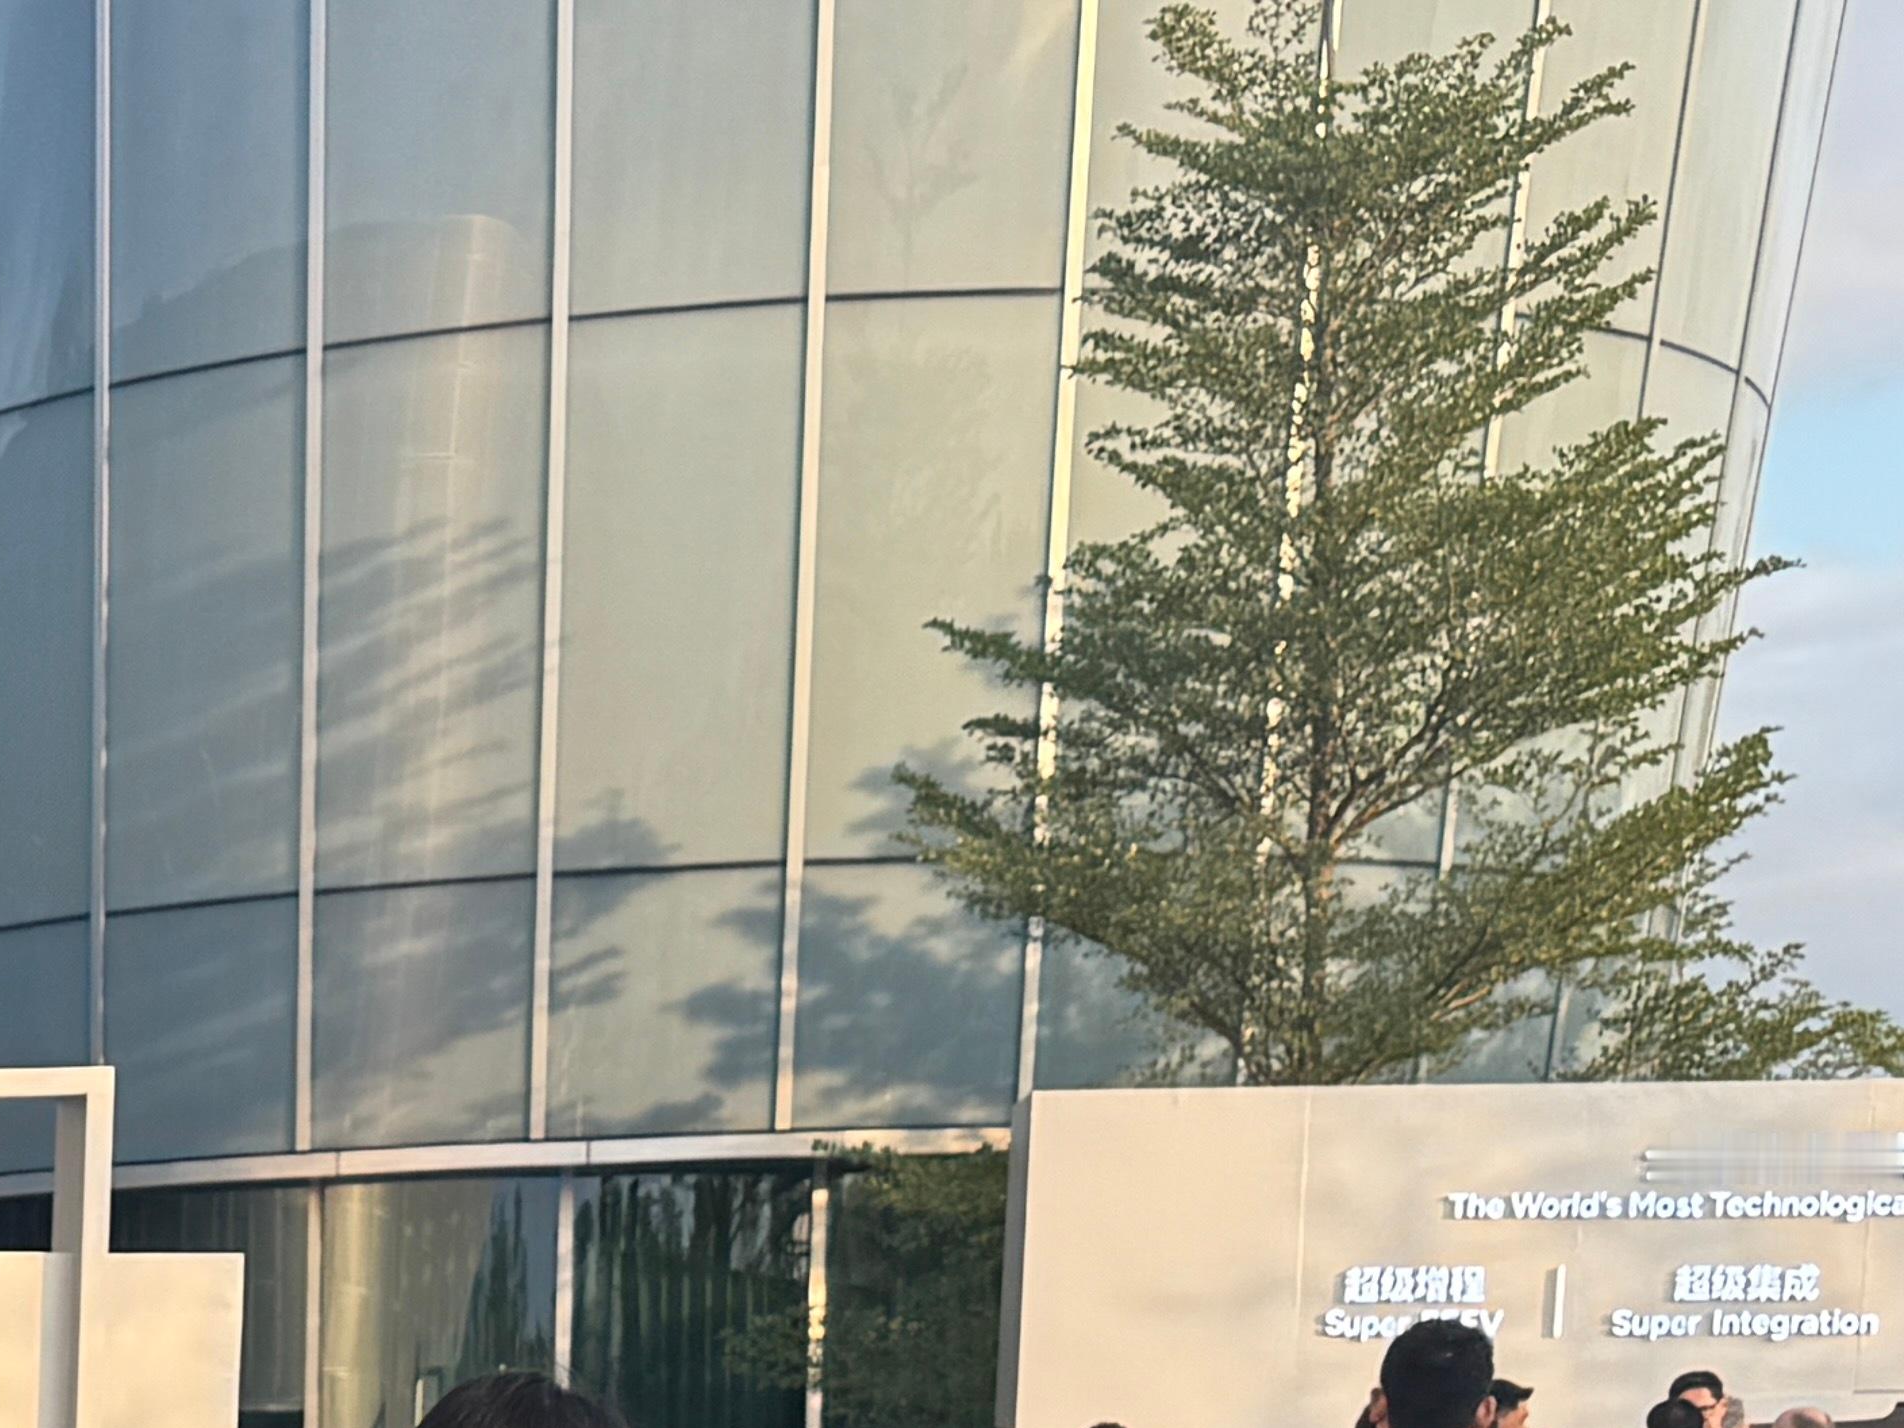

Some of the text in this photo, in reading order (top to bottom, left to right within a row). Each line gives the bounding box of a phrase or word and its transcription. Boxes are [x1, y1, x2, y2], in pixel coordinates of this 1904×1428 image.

[1449, 1192, 1505, 1219] The
[1512, 1190, 1623, 1219] World's
[1628, 1190, 1704, 1218] Most
[1344, 1264, 1486, 1303] 超级增程
[1674, 1263, 1821, 1302] 超级集成
[1611, 1308, 1880, 1342] Super Integration
